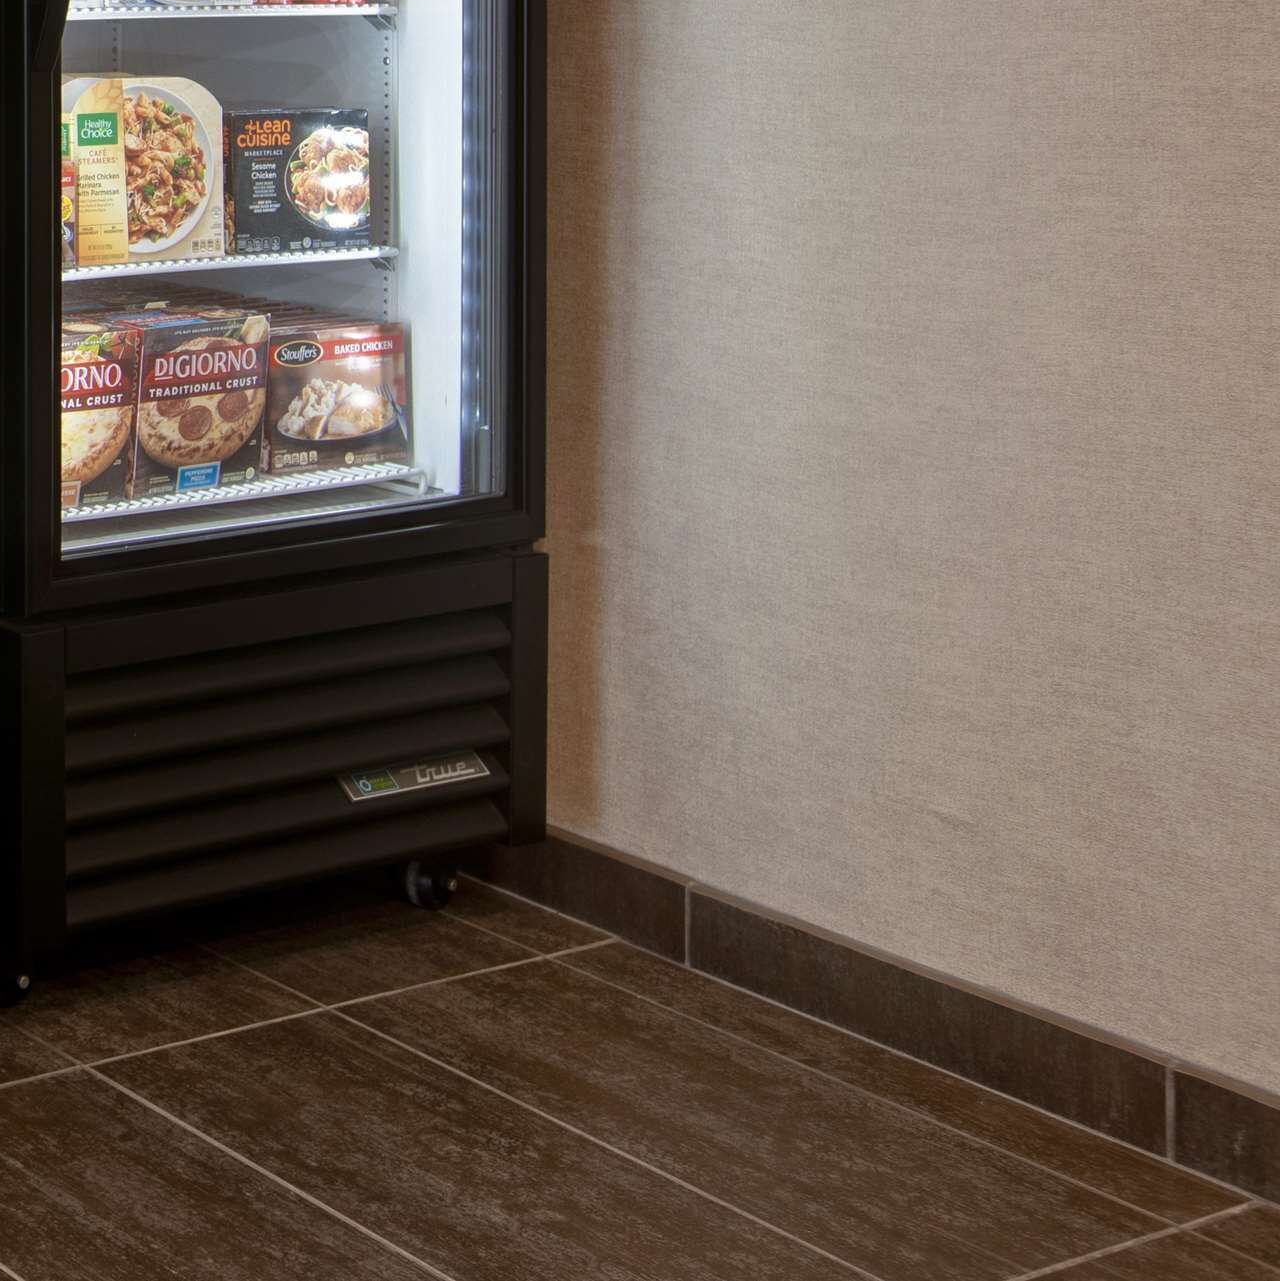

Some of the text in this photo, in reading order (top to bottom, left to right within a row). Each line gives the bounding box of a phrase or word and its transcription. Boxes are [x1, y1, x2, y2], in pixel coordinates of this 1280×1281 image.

[85, 119, 112, 130] Healthy
[255, 119, 290, 133] Lean
[81, 128, 113, 139] Choice
[236, 132, 291, 148] cuisine
[244, 149, 284, 157] MARKETPLACE
[251, 162, 276, 170] Sesame
[96, 173, 120, 181] Chicken
[251, 171, 277, 180] Chicken
[334, 339, 394, 355] BAKED CHICKEN
[281, 345, 318, 363] Stouffer's
[149, 375, 258, 398] TRADITIONAL CRUST
[85, 394, 124, 407] CRUST
[398, 761, 476, 784] true
